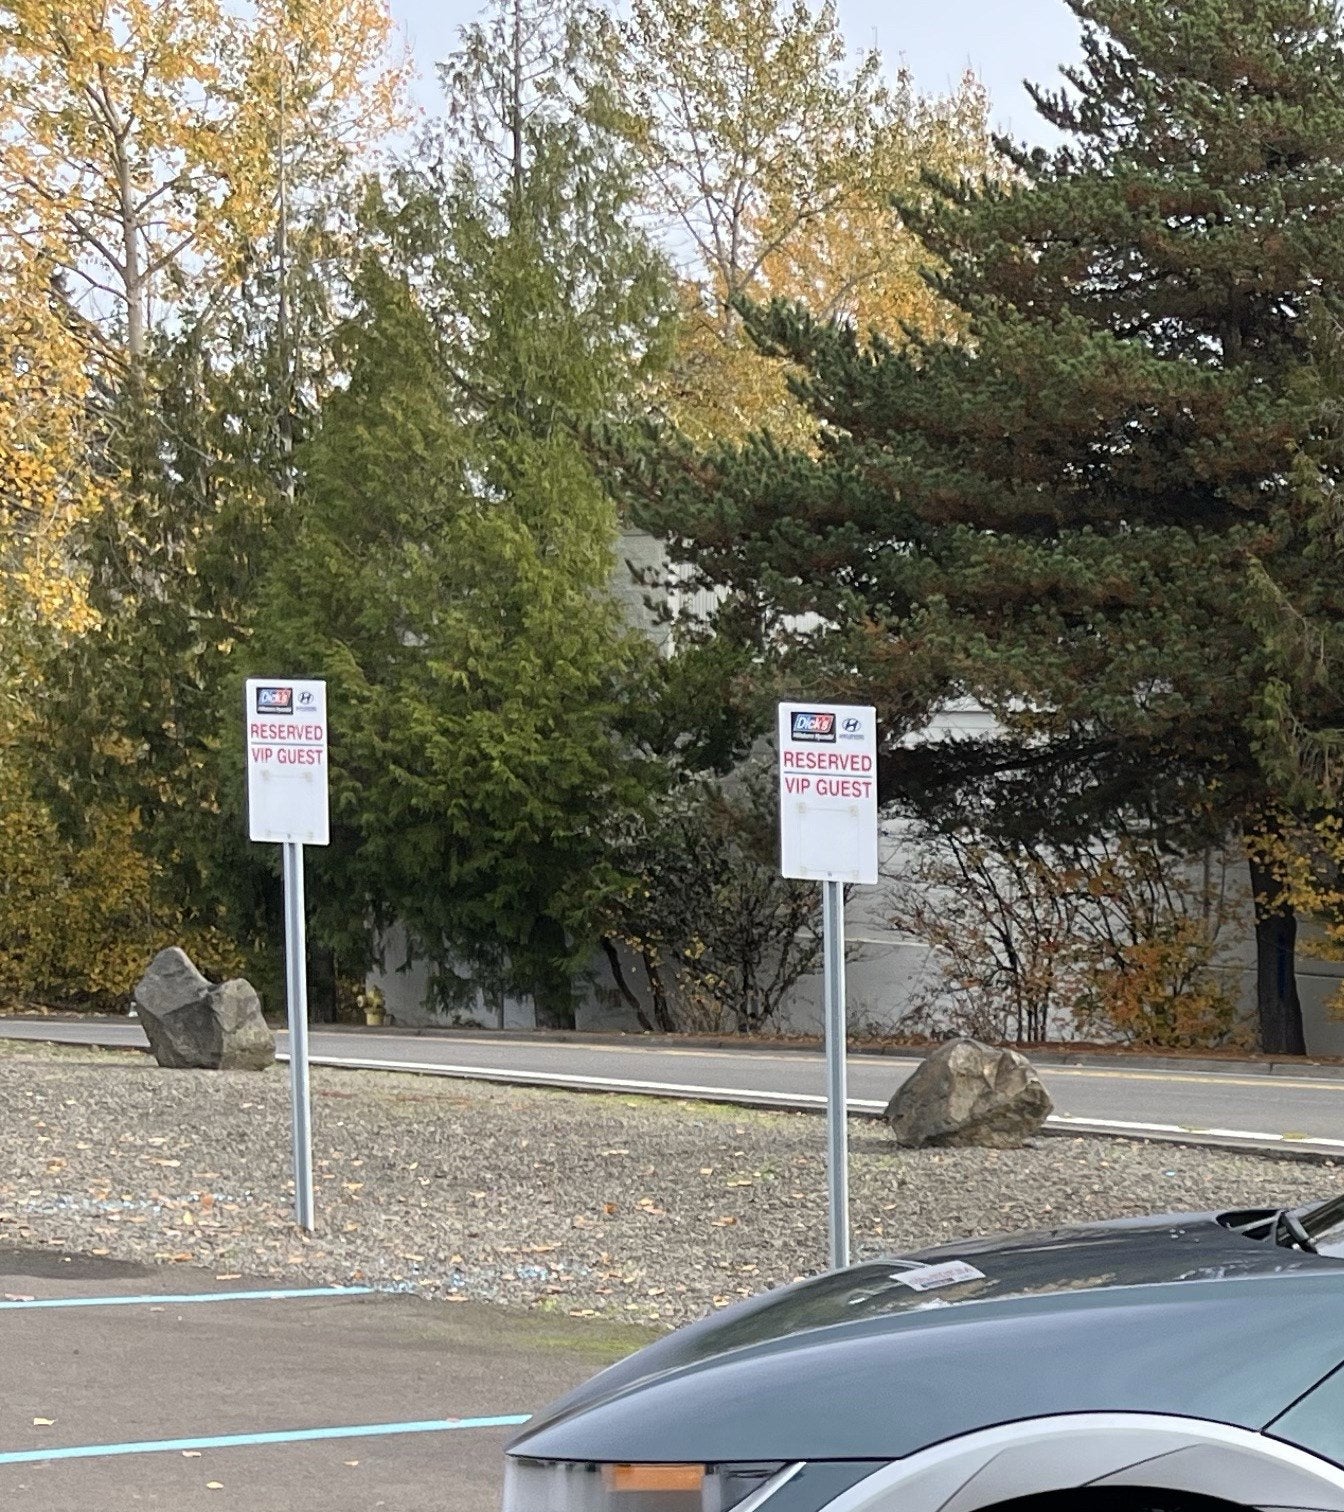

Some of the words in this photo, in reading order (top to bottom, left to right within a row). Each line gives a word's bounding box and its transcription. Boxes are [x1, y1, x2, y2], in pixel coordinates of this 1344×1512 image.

[251, 724, 323, 741] RESERVED
[252, 748, 273, 763] VIP
[277, 749, 323, 765] GUEST
[784, 751, 872, 772] RESERVED
[785, 778, 811, 794] VIP
[816, 779, 872, 798] GUEST
